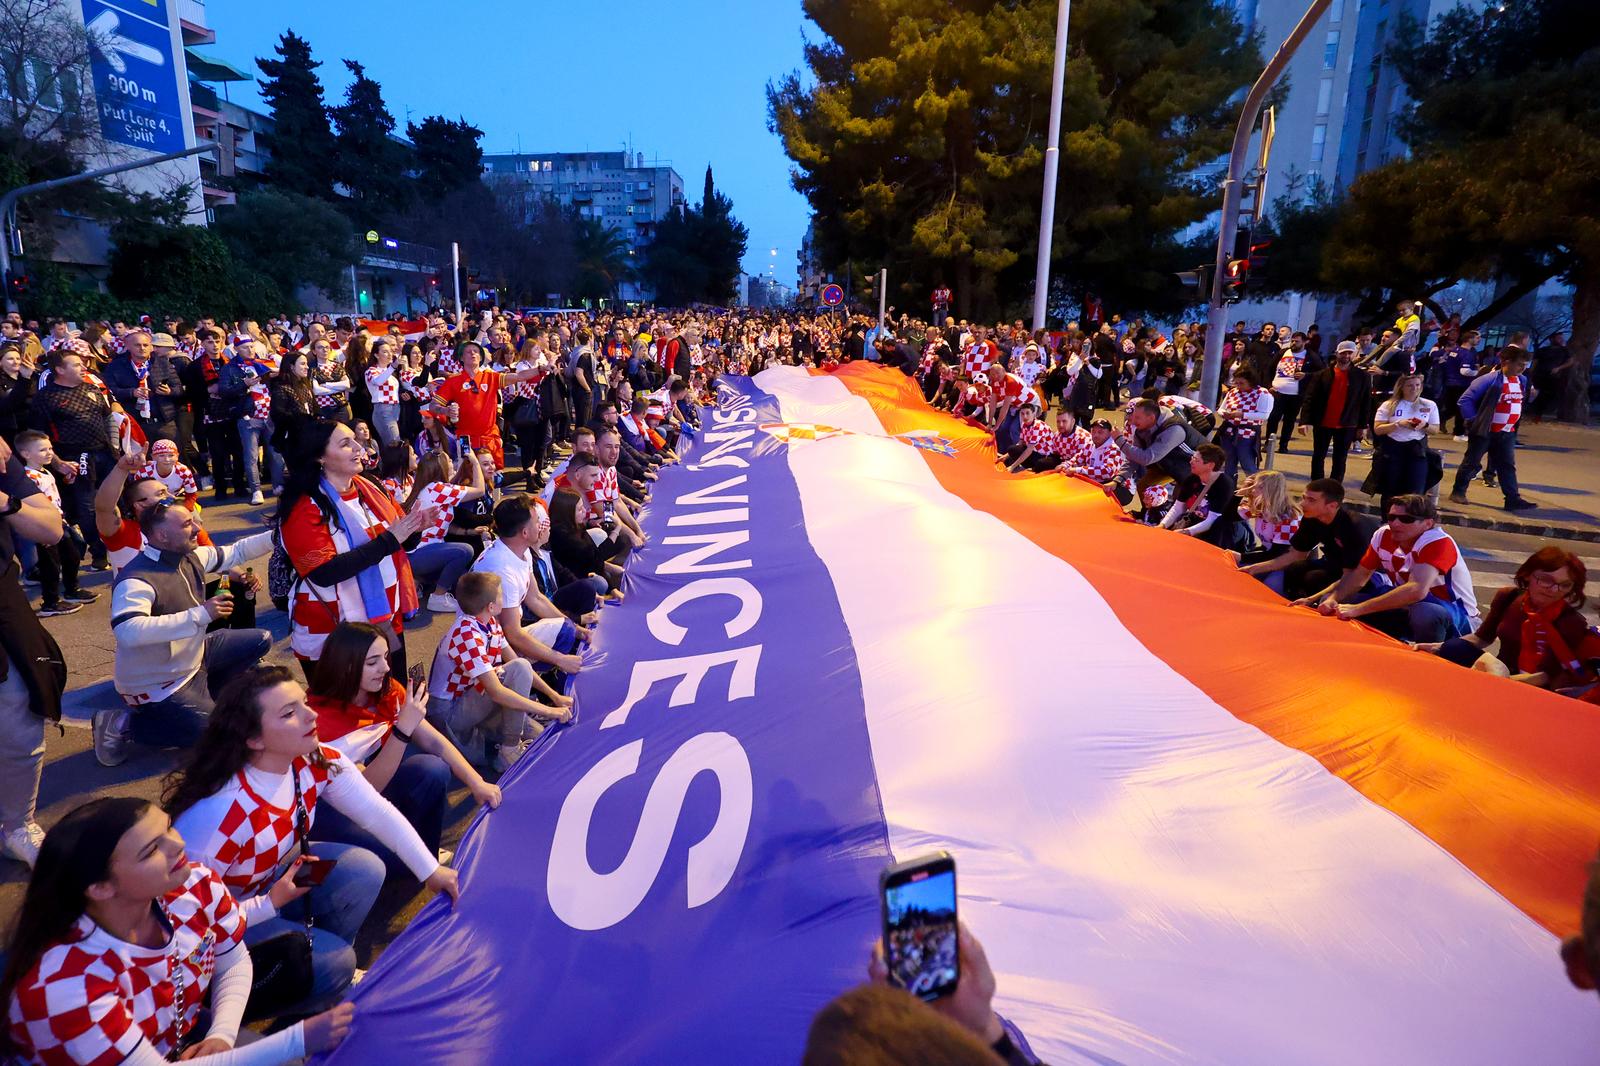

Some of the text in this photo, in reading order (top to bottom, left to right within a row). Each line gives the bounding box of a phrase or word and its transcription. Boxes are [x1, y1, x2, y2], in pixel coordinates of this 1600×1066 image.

[141, 88, 156, 103] m
[102, 102, 127, 121] Put
[158, 118, 171, 135] 4,
[546, 474, 763, 931] VINCES
